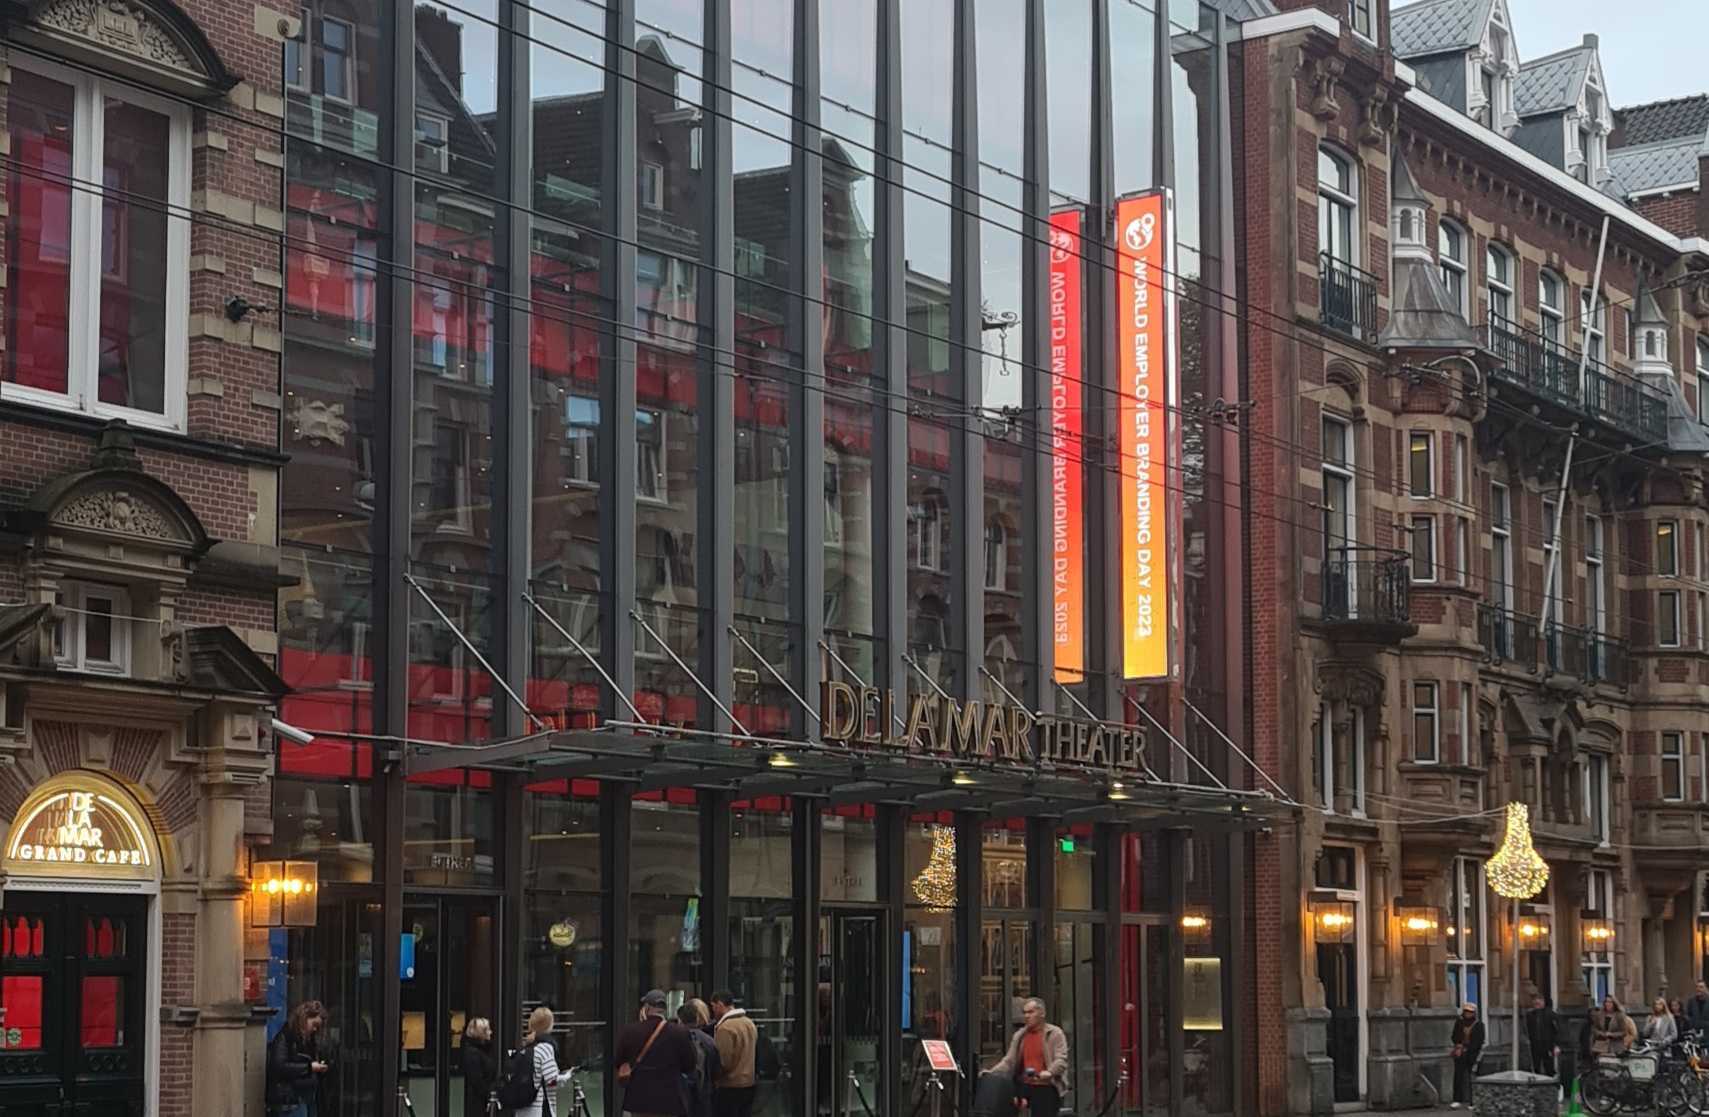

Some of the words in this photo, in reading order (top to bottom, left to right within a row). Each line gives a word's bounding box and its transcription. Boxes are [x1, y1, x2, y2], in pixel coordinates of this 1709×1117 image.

[1134, 257, 1148, 327] WORLD
[1135, 334, 1150, 437] EMPLOYER
[1136, 443, 1151, 544] BRANDING
[1136, 549, 1152, 588] DAY
[1037, 715, 1147, 768] THEATER
[67, 809, 92, 828] LA
[70, 792, 96, 811] DE
[20, 844, 86, 862] GRAND
[95, 848, 141, 865] CAFE
[58, 825, 103, 848] MAR
